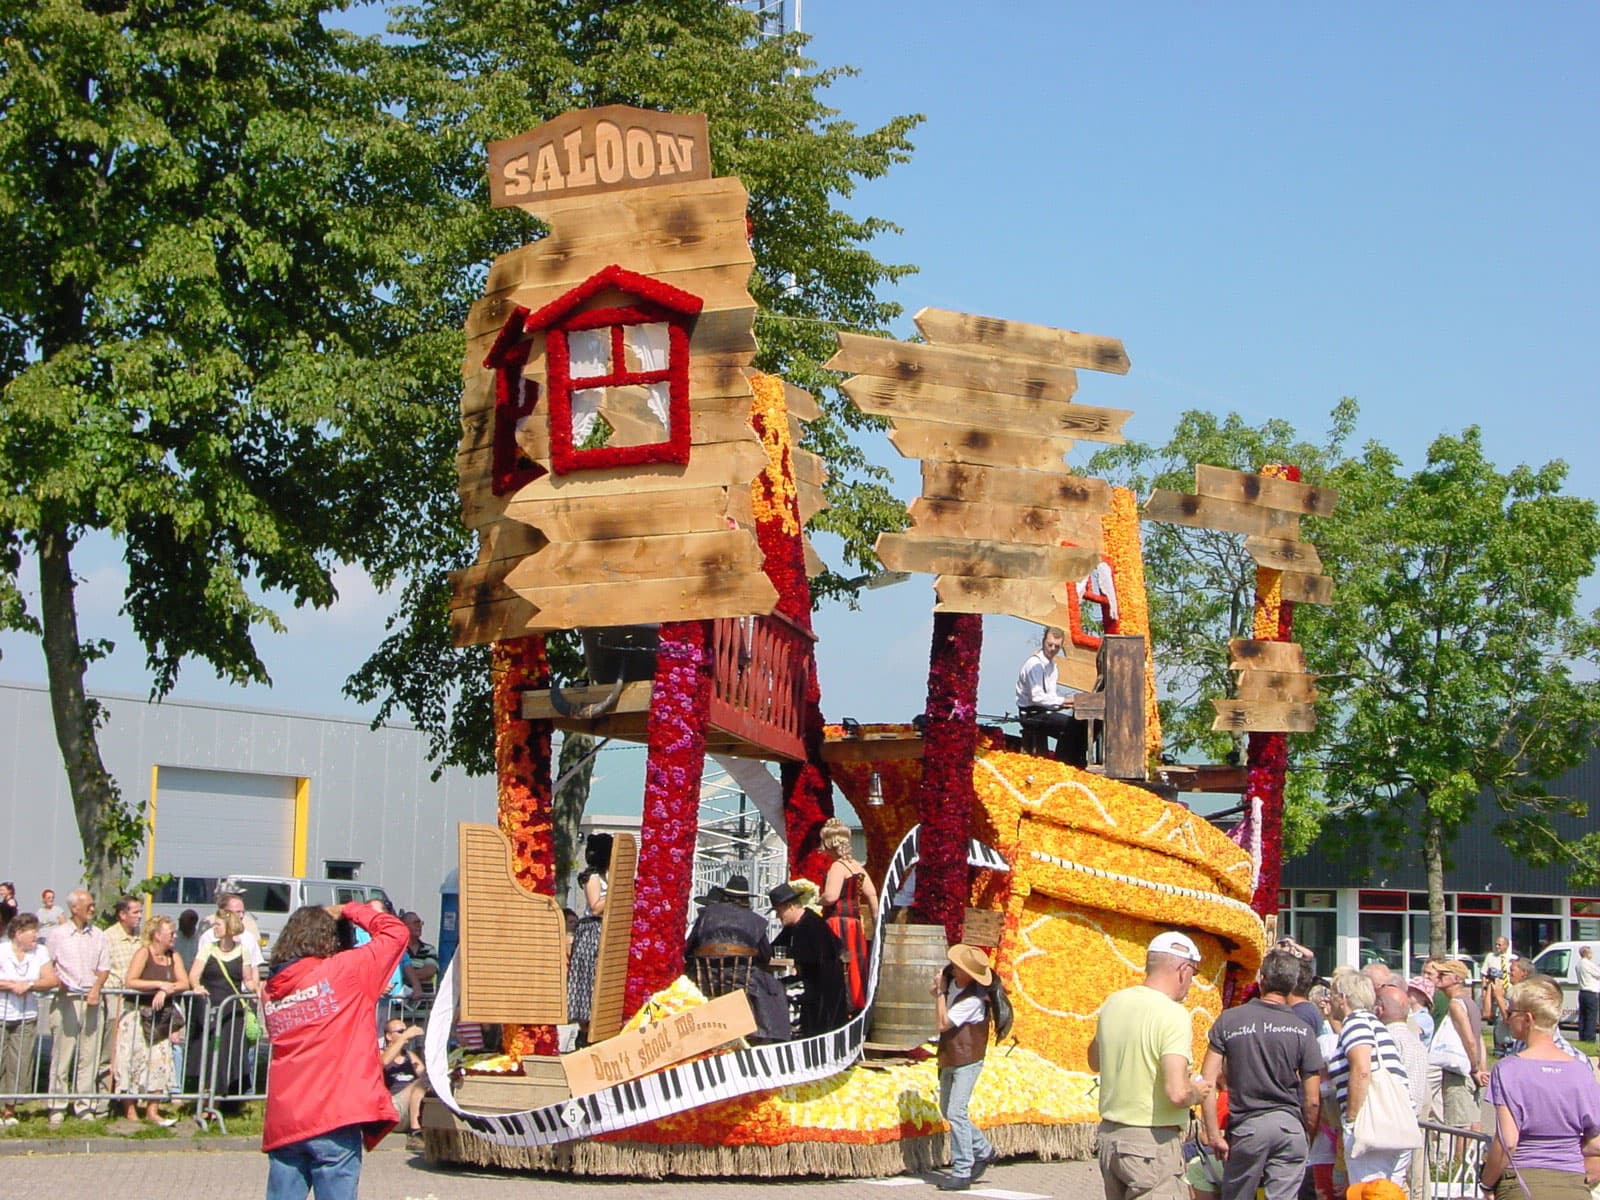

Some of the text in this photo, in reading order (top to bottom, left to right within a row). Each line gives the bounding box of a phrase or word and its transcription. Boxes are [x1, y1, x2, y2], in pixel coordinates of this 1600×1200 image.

[502, 119, 695, 197] SALOON
[1263, 1022, 1308, 1037] Movement
[590, 1052, 634, 1082] Don't
[639, 1025, 672, 1069] shoot
[569, 1107, 576, 1123] 5
